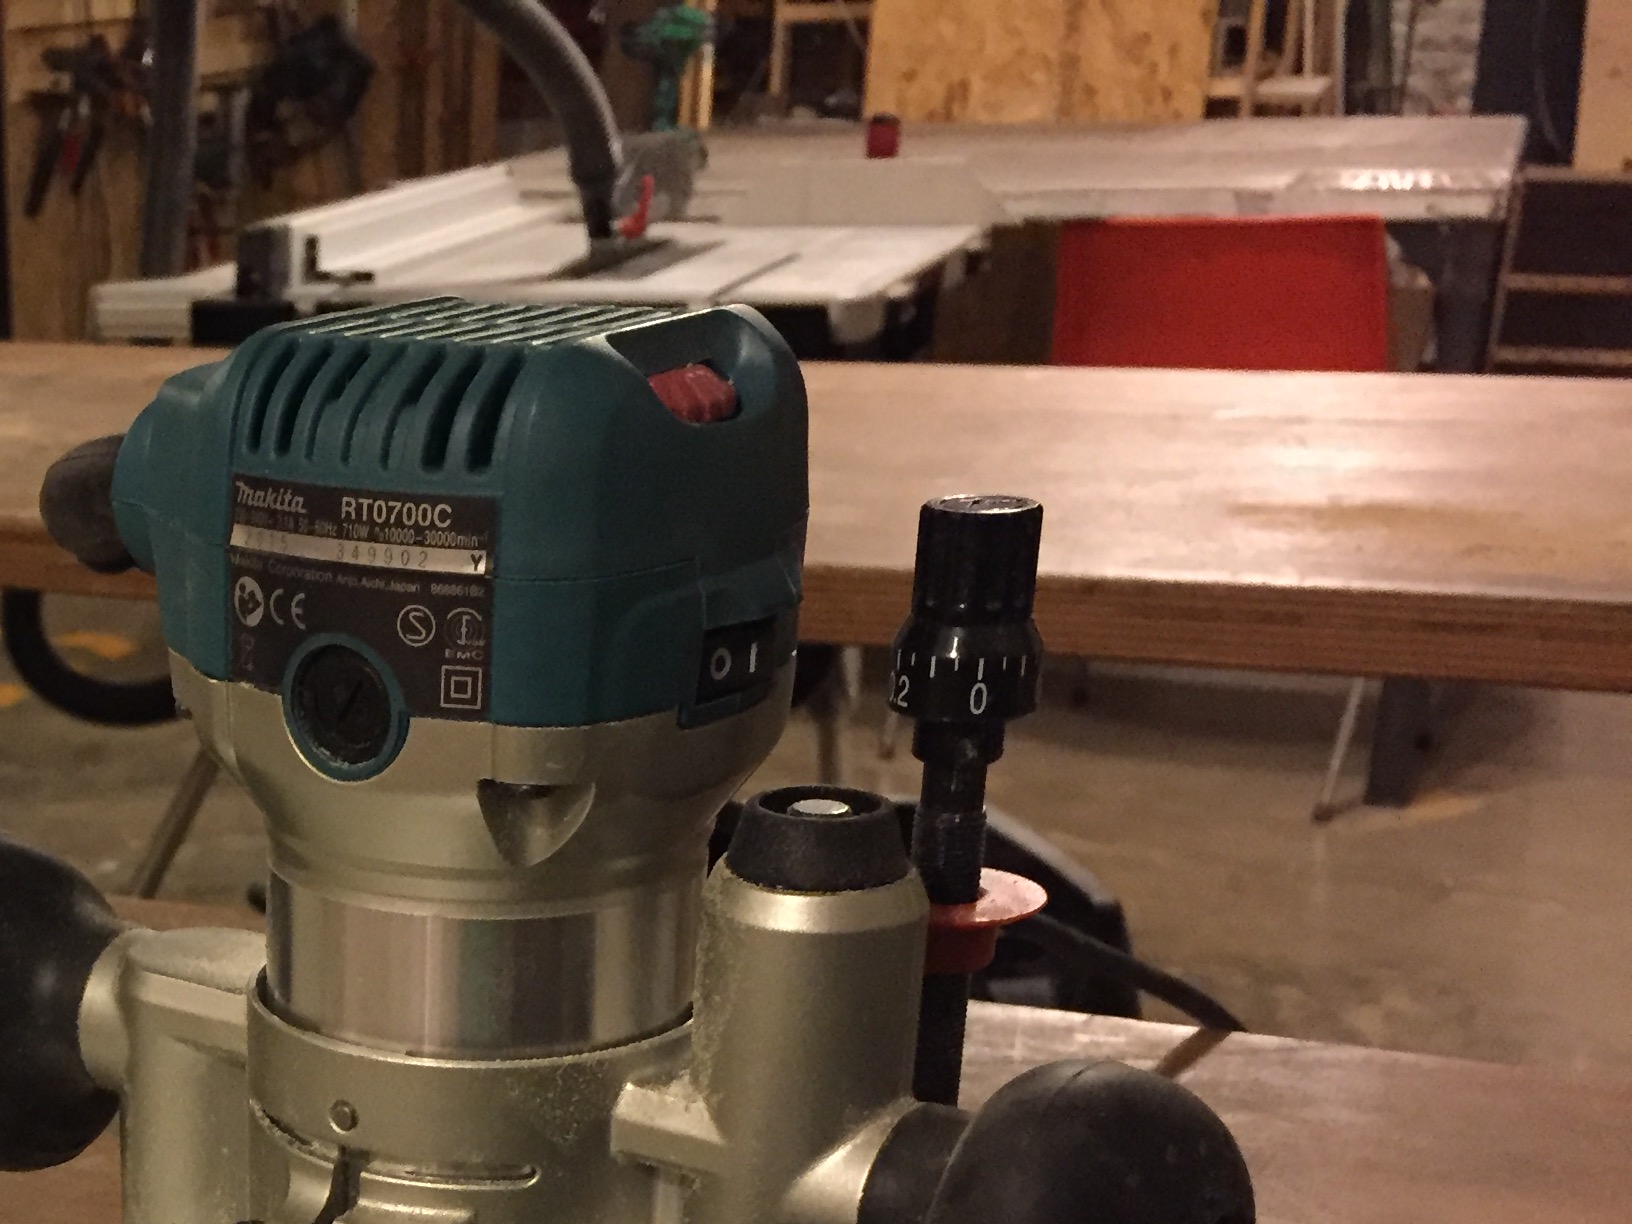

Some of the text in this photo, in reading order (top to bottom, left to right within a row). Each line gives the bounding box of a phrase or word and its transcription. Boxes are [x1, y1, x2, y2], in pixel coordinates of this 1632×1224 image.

[341, 497, 452, 528] RT0700C
[270, 588, 306, 630] CE
[969, 682, 988, 715] 0
